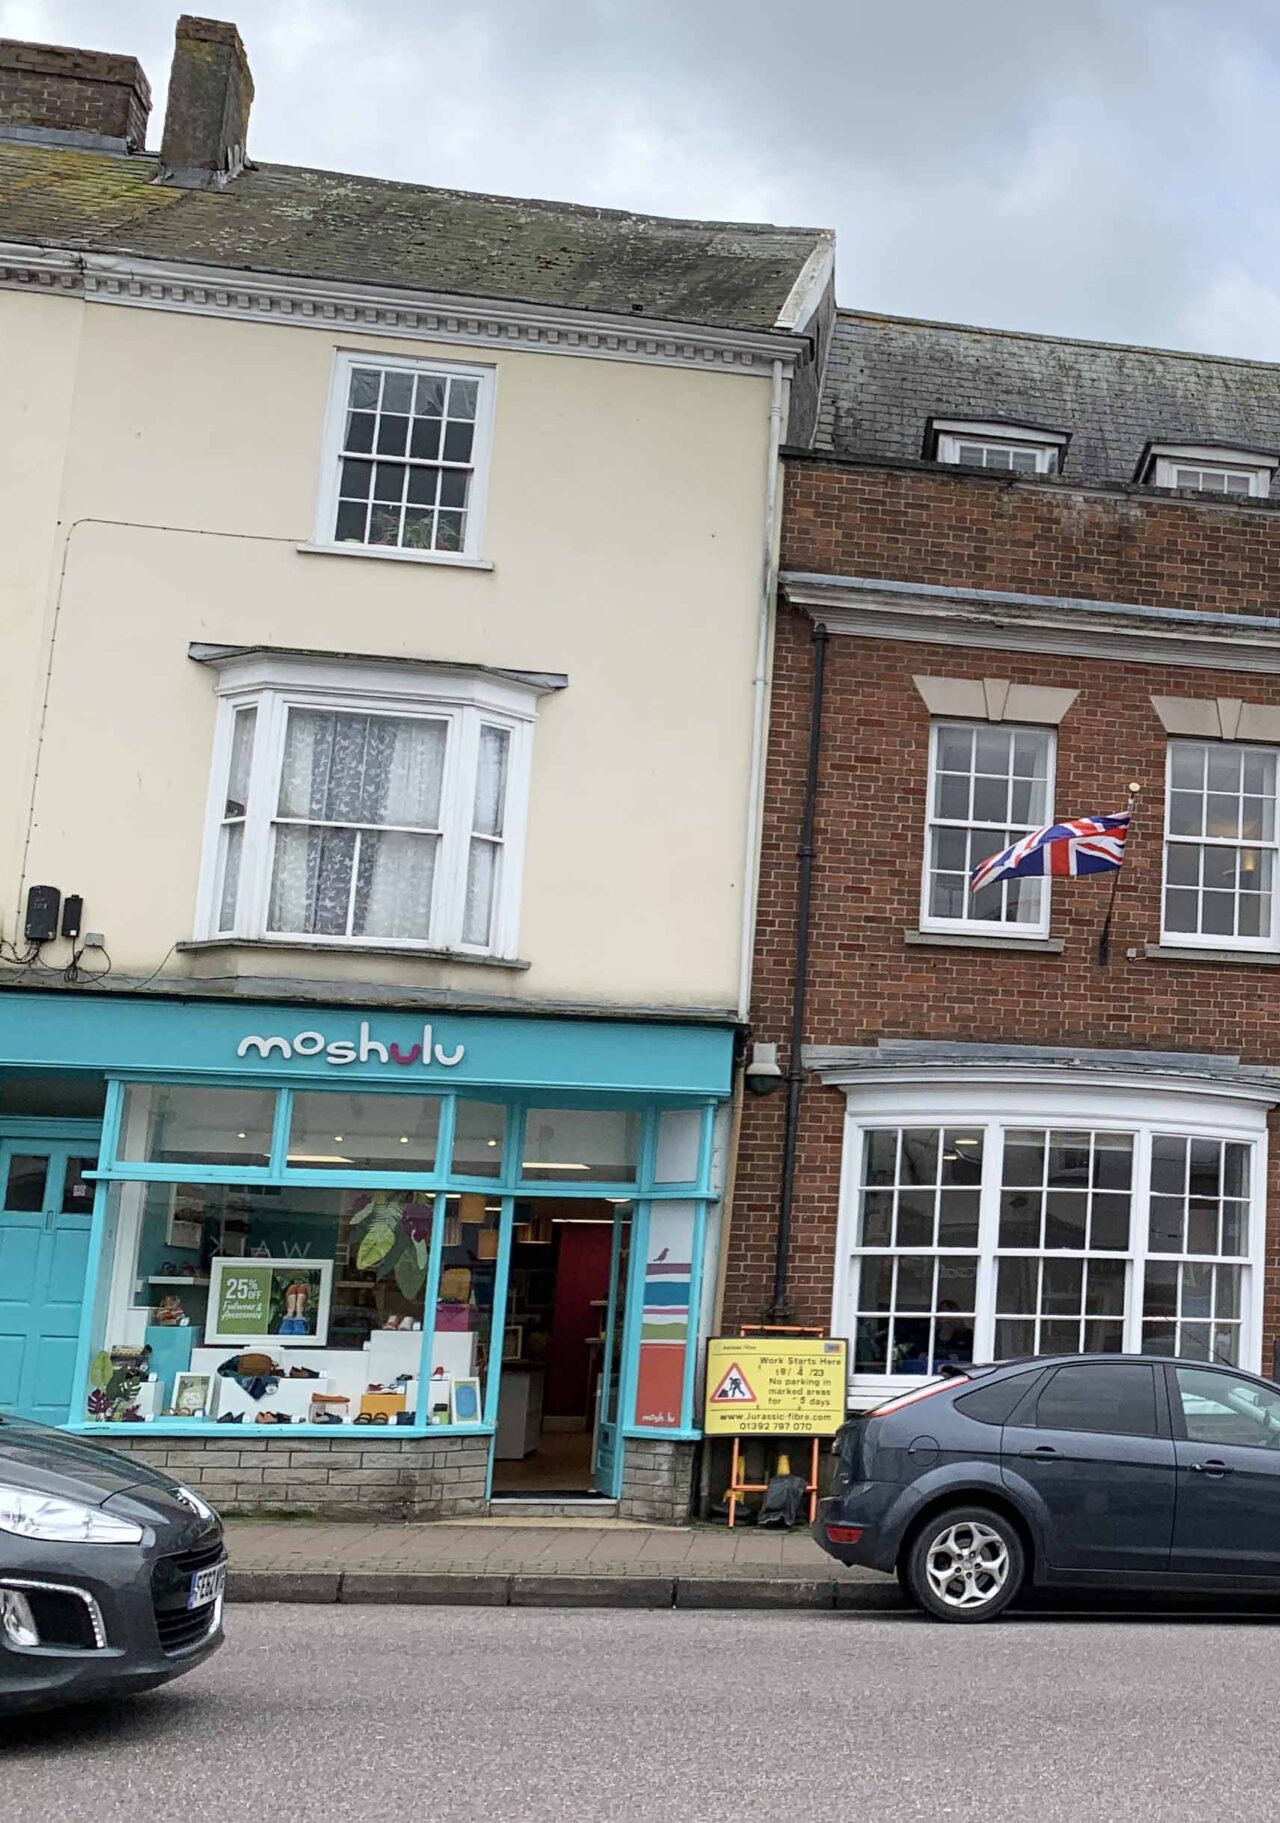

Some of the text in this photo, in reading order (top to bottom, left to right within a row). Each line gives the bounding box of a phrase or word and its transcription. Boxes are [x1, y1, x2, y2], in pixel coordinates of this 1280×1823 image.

[237, 1021, 465, 1066] moshulu
[760, 1357, 783, 1365] Work
[788, 1357, 816, 1365] Starts
[785, 1378, 820, 1387] parking
[823, 1378, 831, 1386] in
[768, 1387, 803, 1395] marked
[768, 1397, 781, 1405] for
[809, 1397, 830, 1406] days
[641, 1411, 676, 1423] moshlu
[740, 1422, 812, 1431] 01392 797 070
